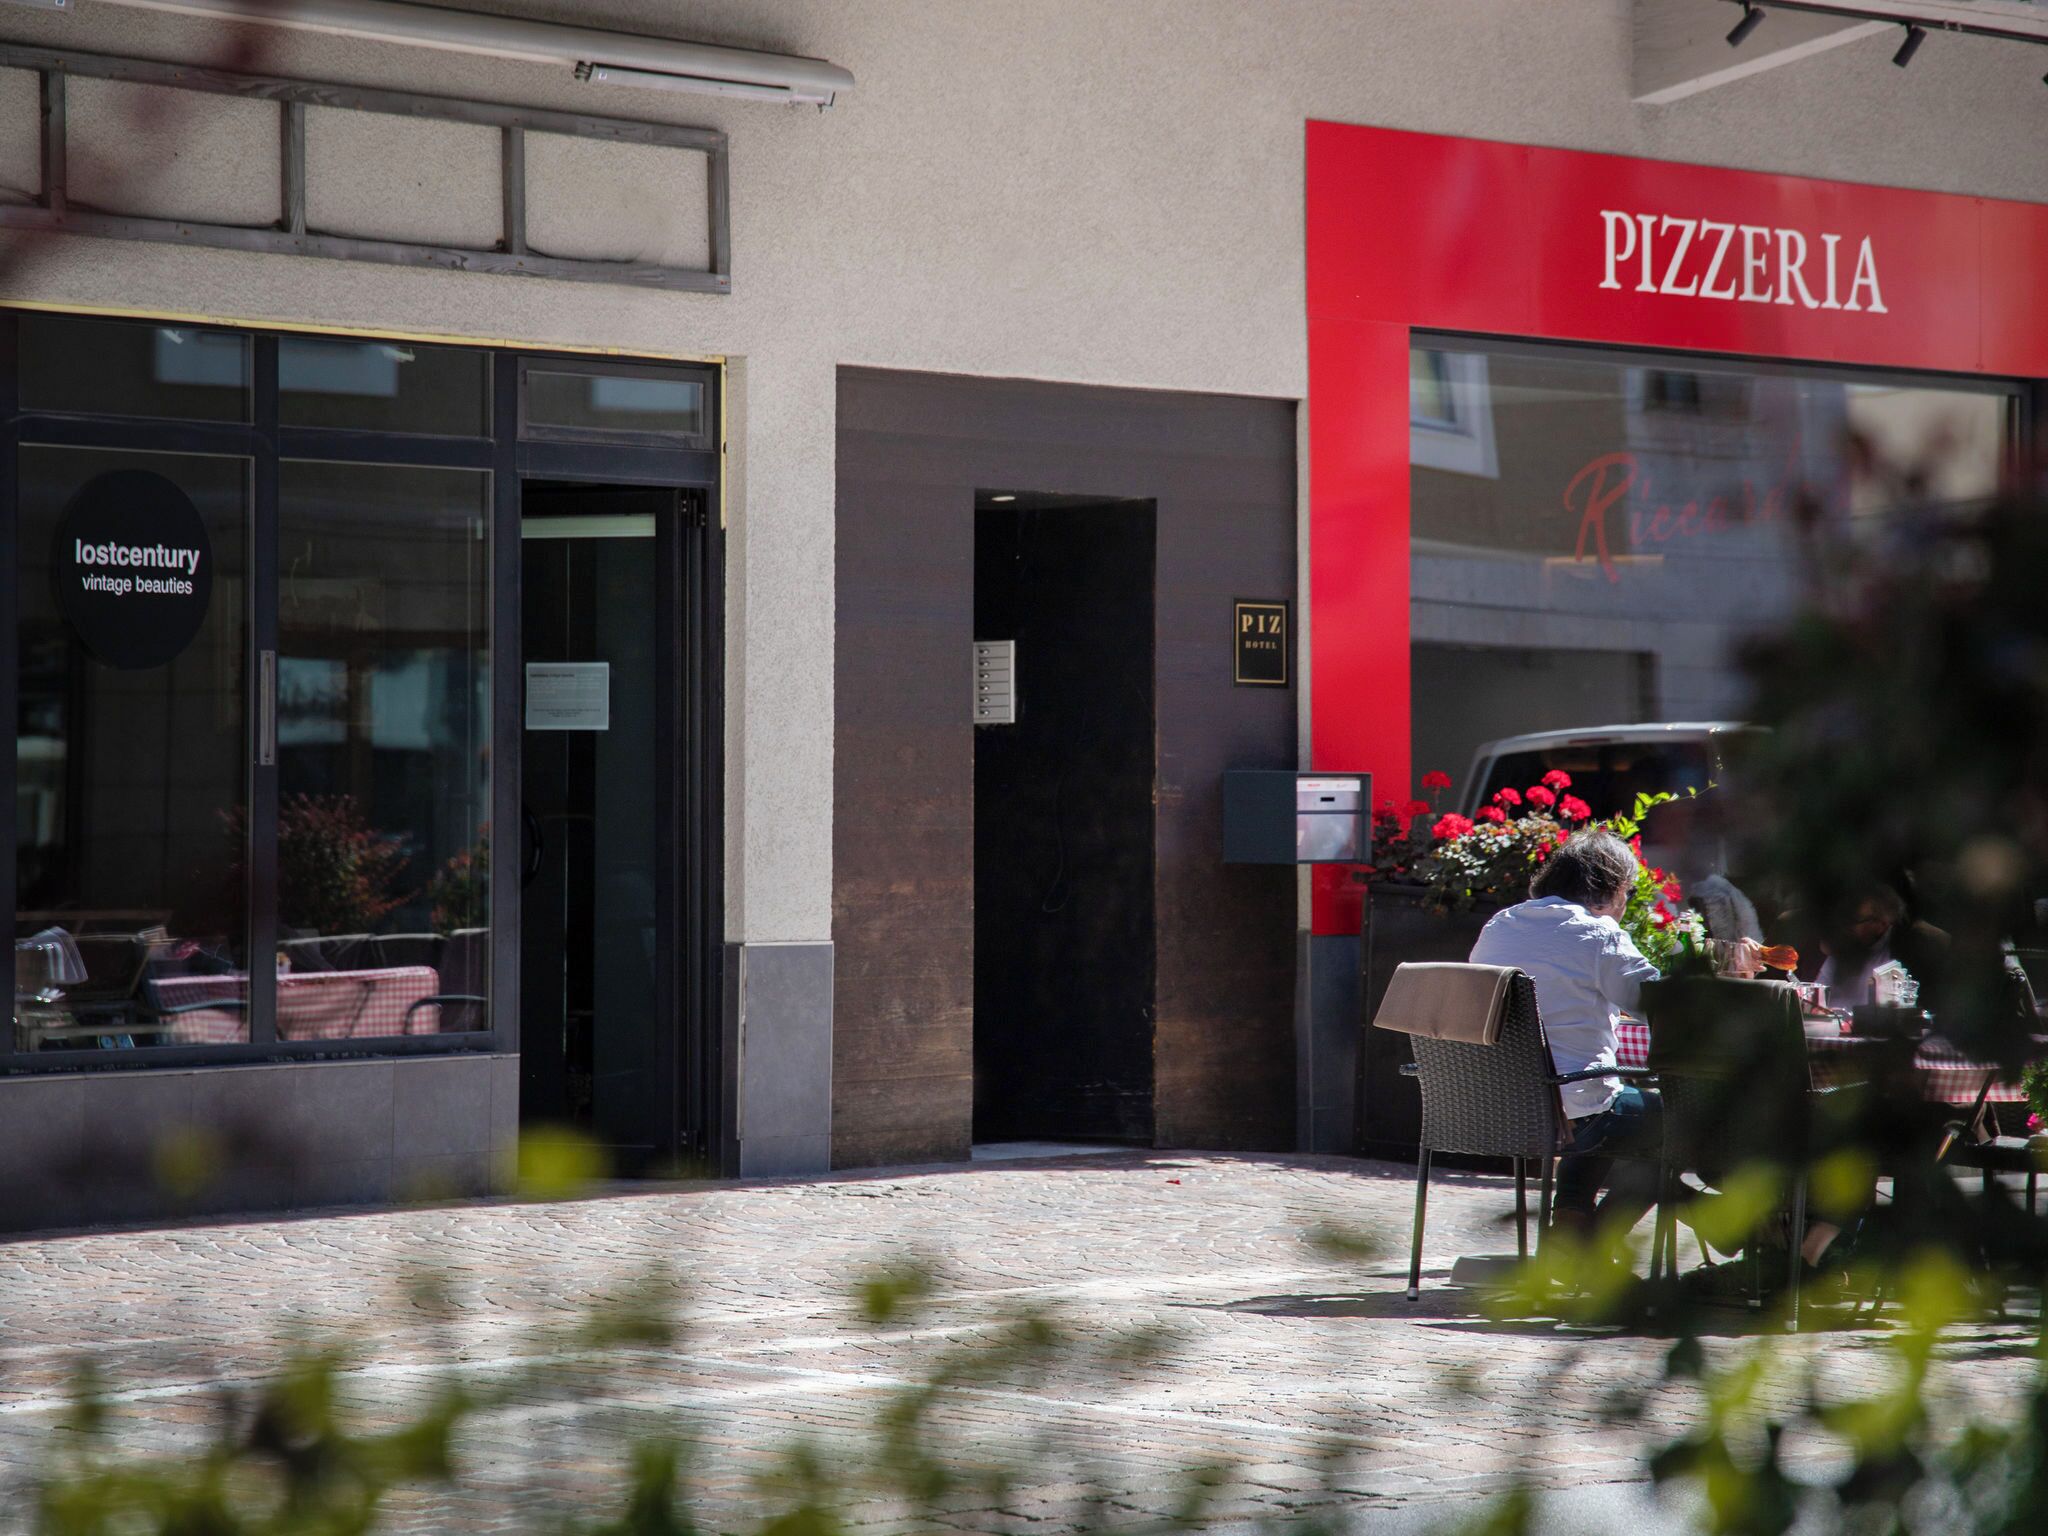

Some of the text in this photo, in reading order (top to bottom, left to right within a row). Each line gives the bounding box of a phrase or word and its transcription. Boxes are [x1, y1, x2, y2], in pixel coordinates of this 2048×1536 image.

[1599, 210, 1888, 313] PIZZERIA
[75, 538, 200, 575] lostcentury
[82, 573, 193, 596] vintage beauties
[1241, 614, 1281, 634] PIZ
[1245, 640, 1277, 649] HOTEL
